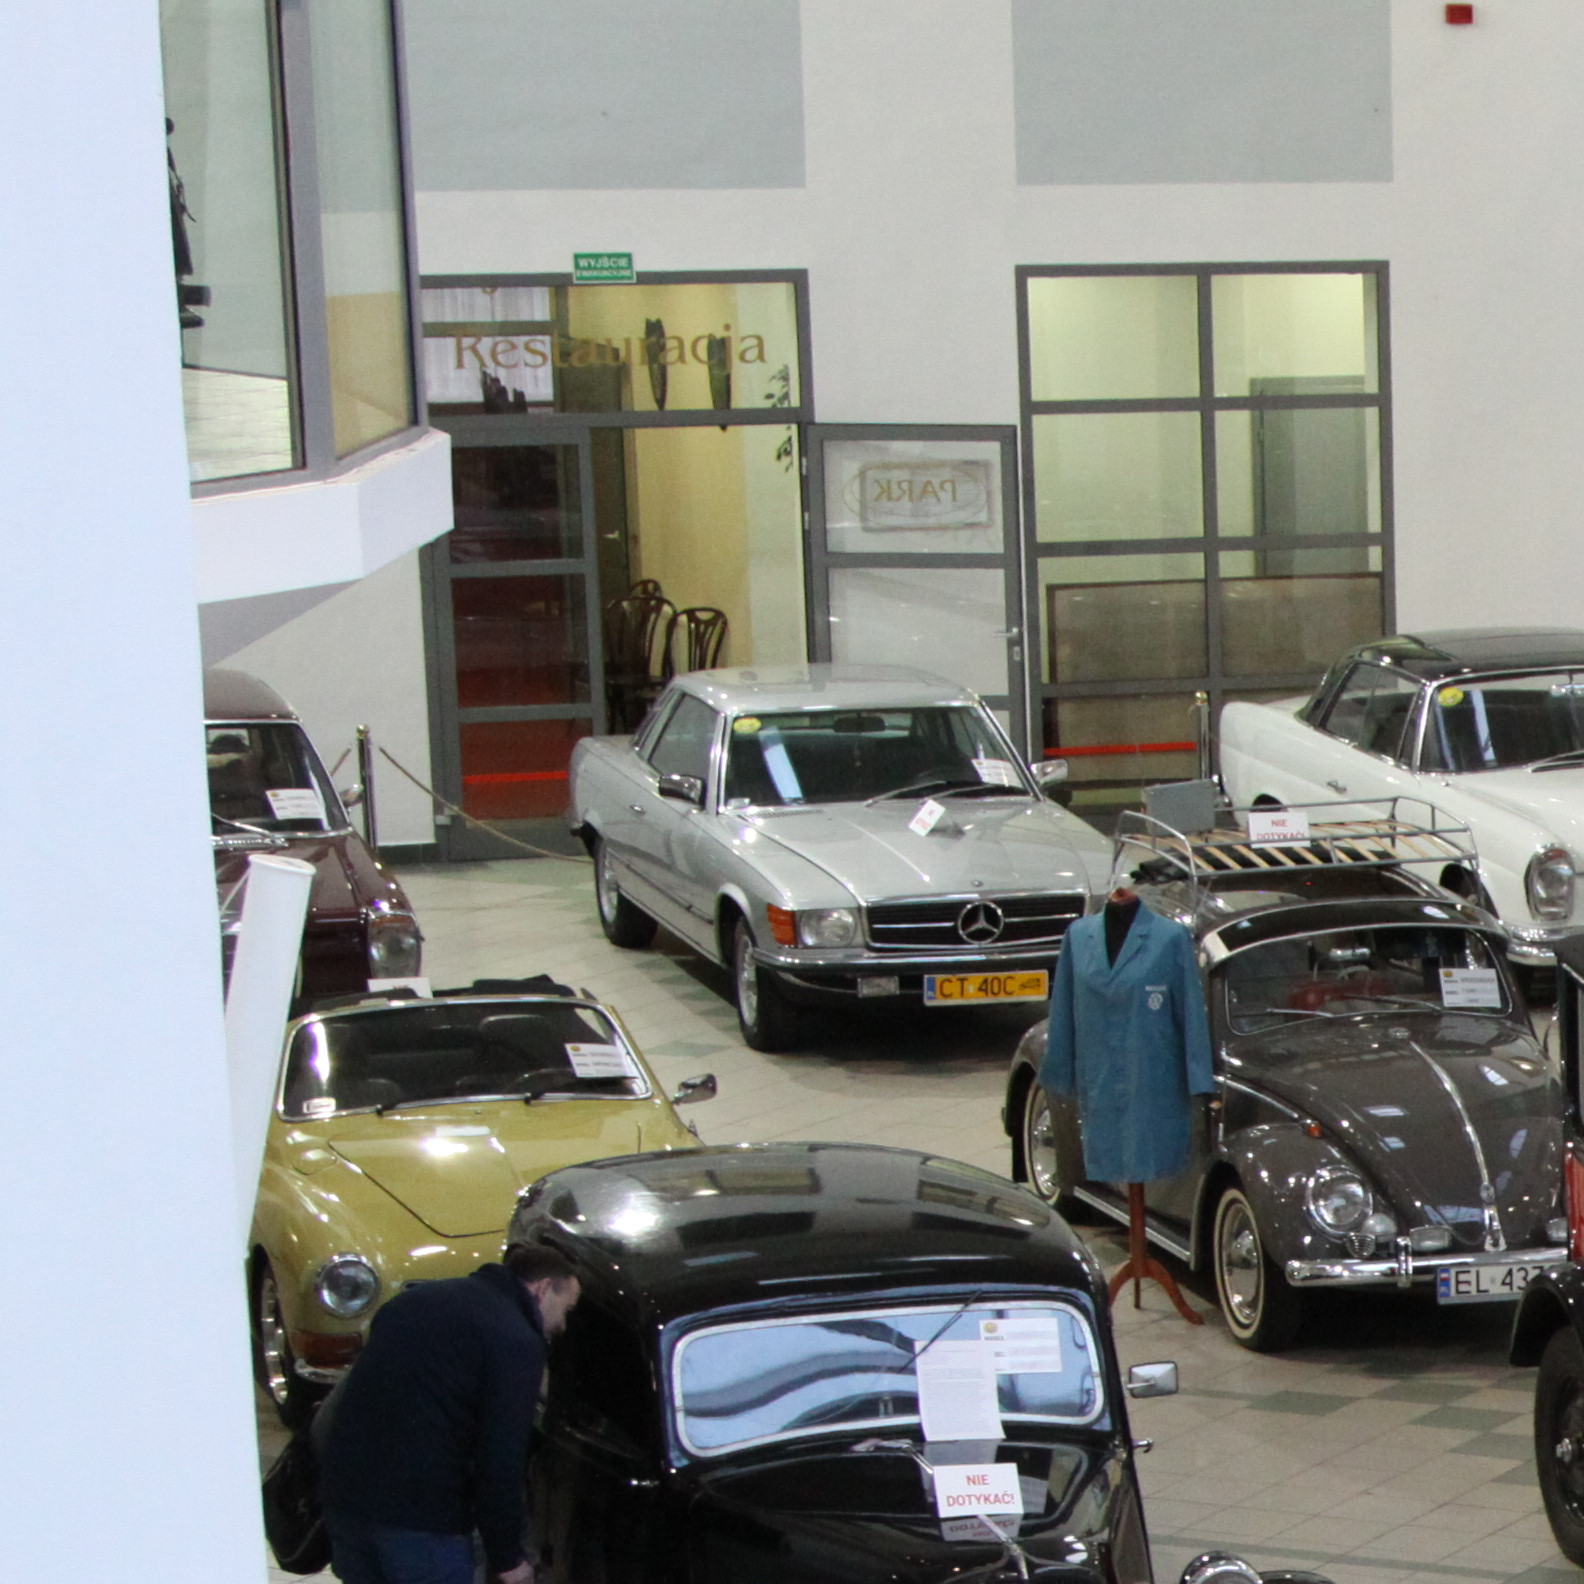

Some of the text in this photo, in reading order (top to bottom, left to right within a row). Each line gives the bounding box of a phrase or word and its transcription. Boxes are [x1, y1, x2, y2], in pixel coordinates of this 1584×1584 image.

[452, 323, 767, 374] Restauracja
[939, 976, 1015, 998] CT 40C
[1455, 1270, 1490, 1294] EL
[966, 1474, 989, 1486] NIE
[946, 1490, 1015, 1507] DOTYKAĆ!
